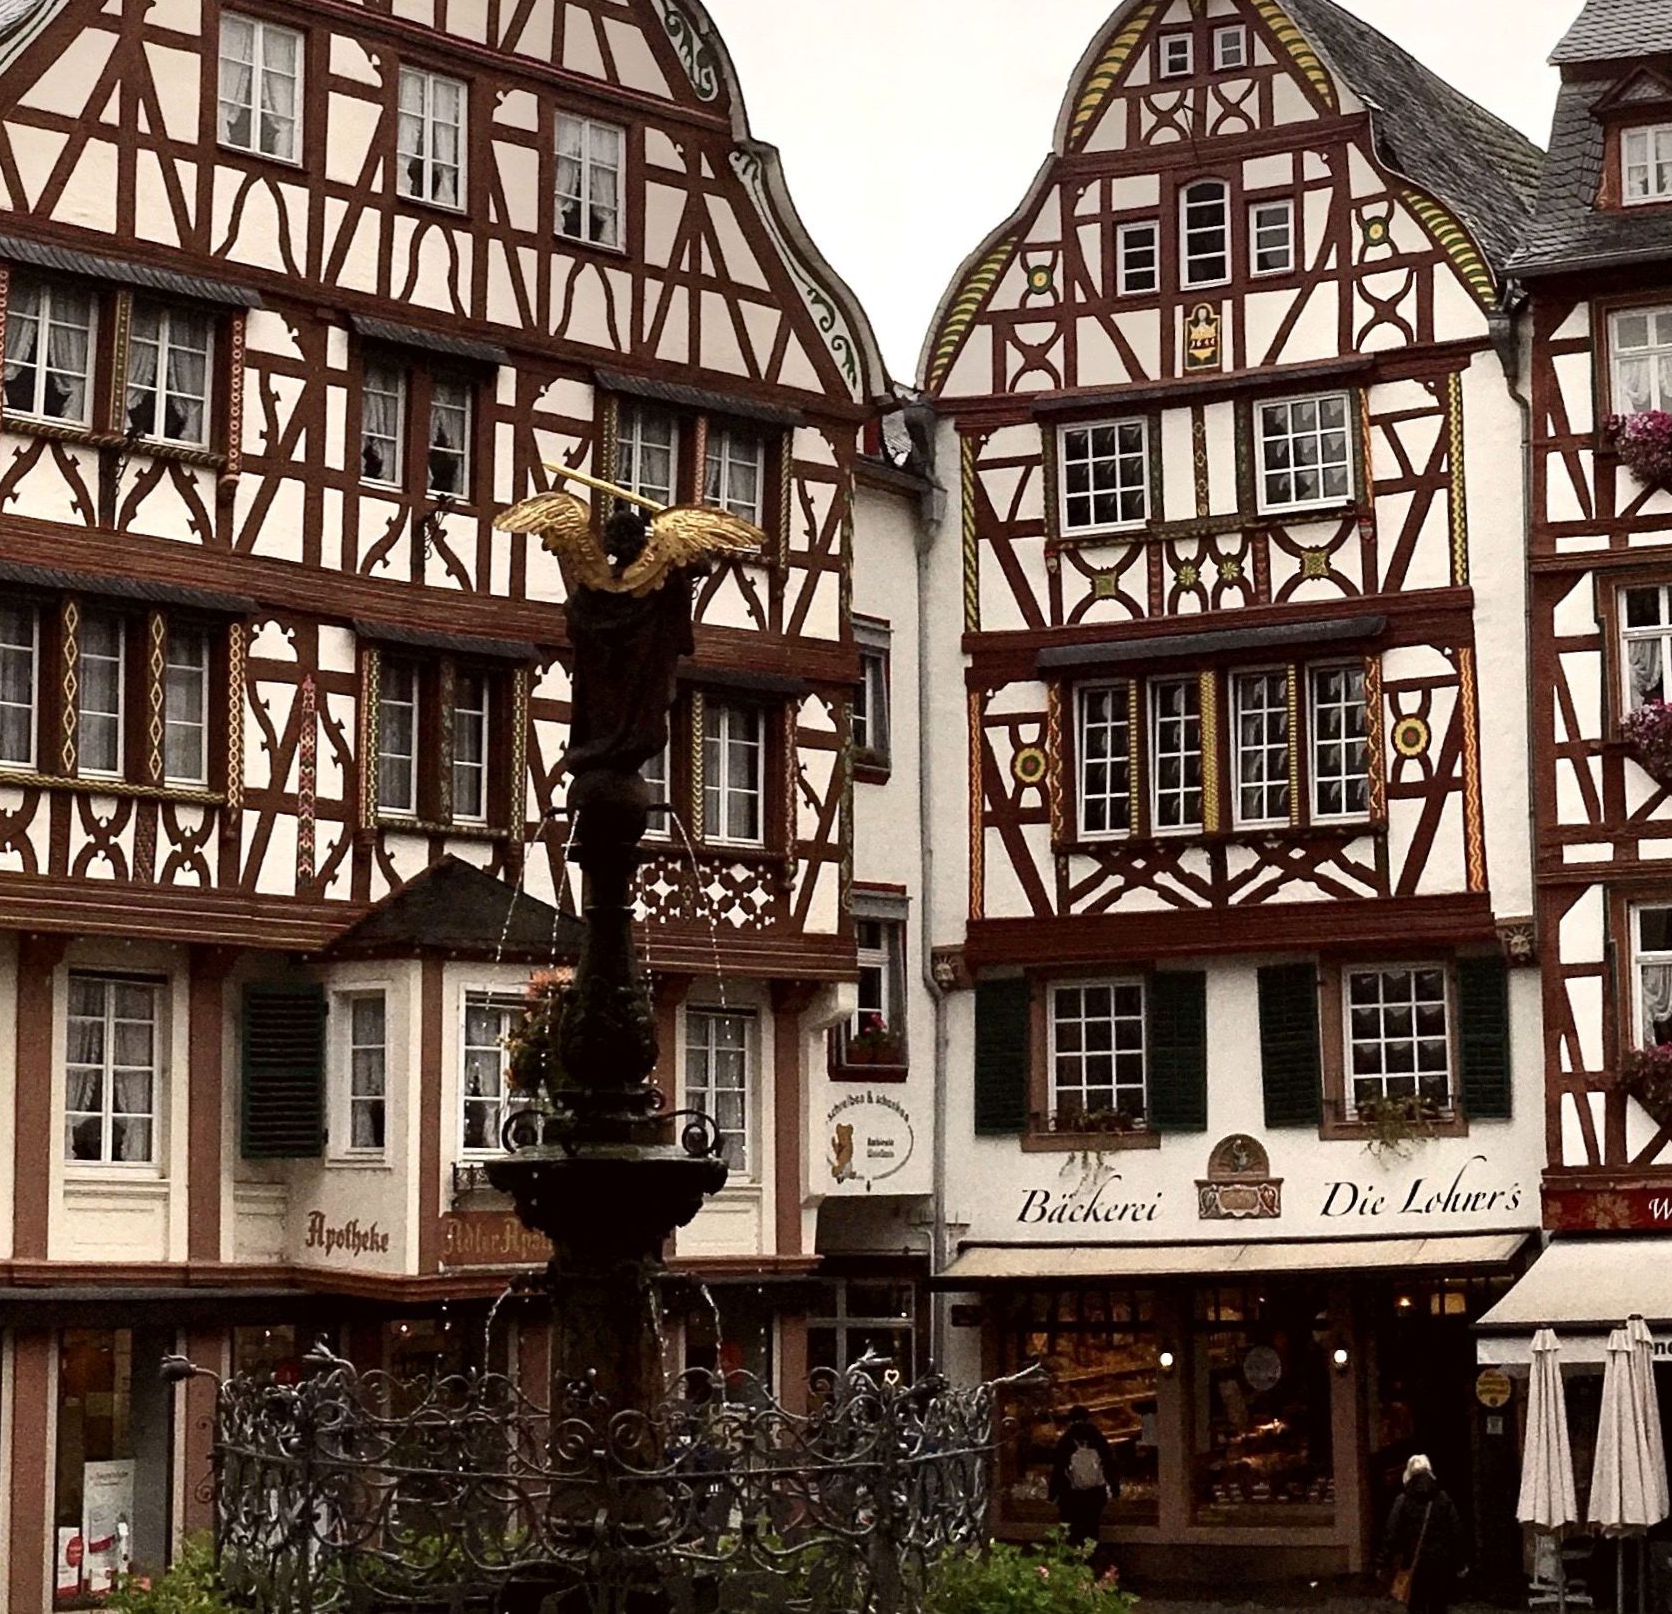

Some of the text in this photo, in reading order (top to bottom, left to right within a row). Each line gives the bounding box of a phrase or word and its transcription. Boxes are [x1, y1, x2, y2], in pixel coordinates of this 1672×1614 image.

[1017, 1175, 1163, 1224] Bäckerei
[1320, 1181, 1385, 1218] Die
[305, 1210, 389, 1256] Apotheke
